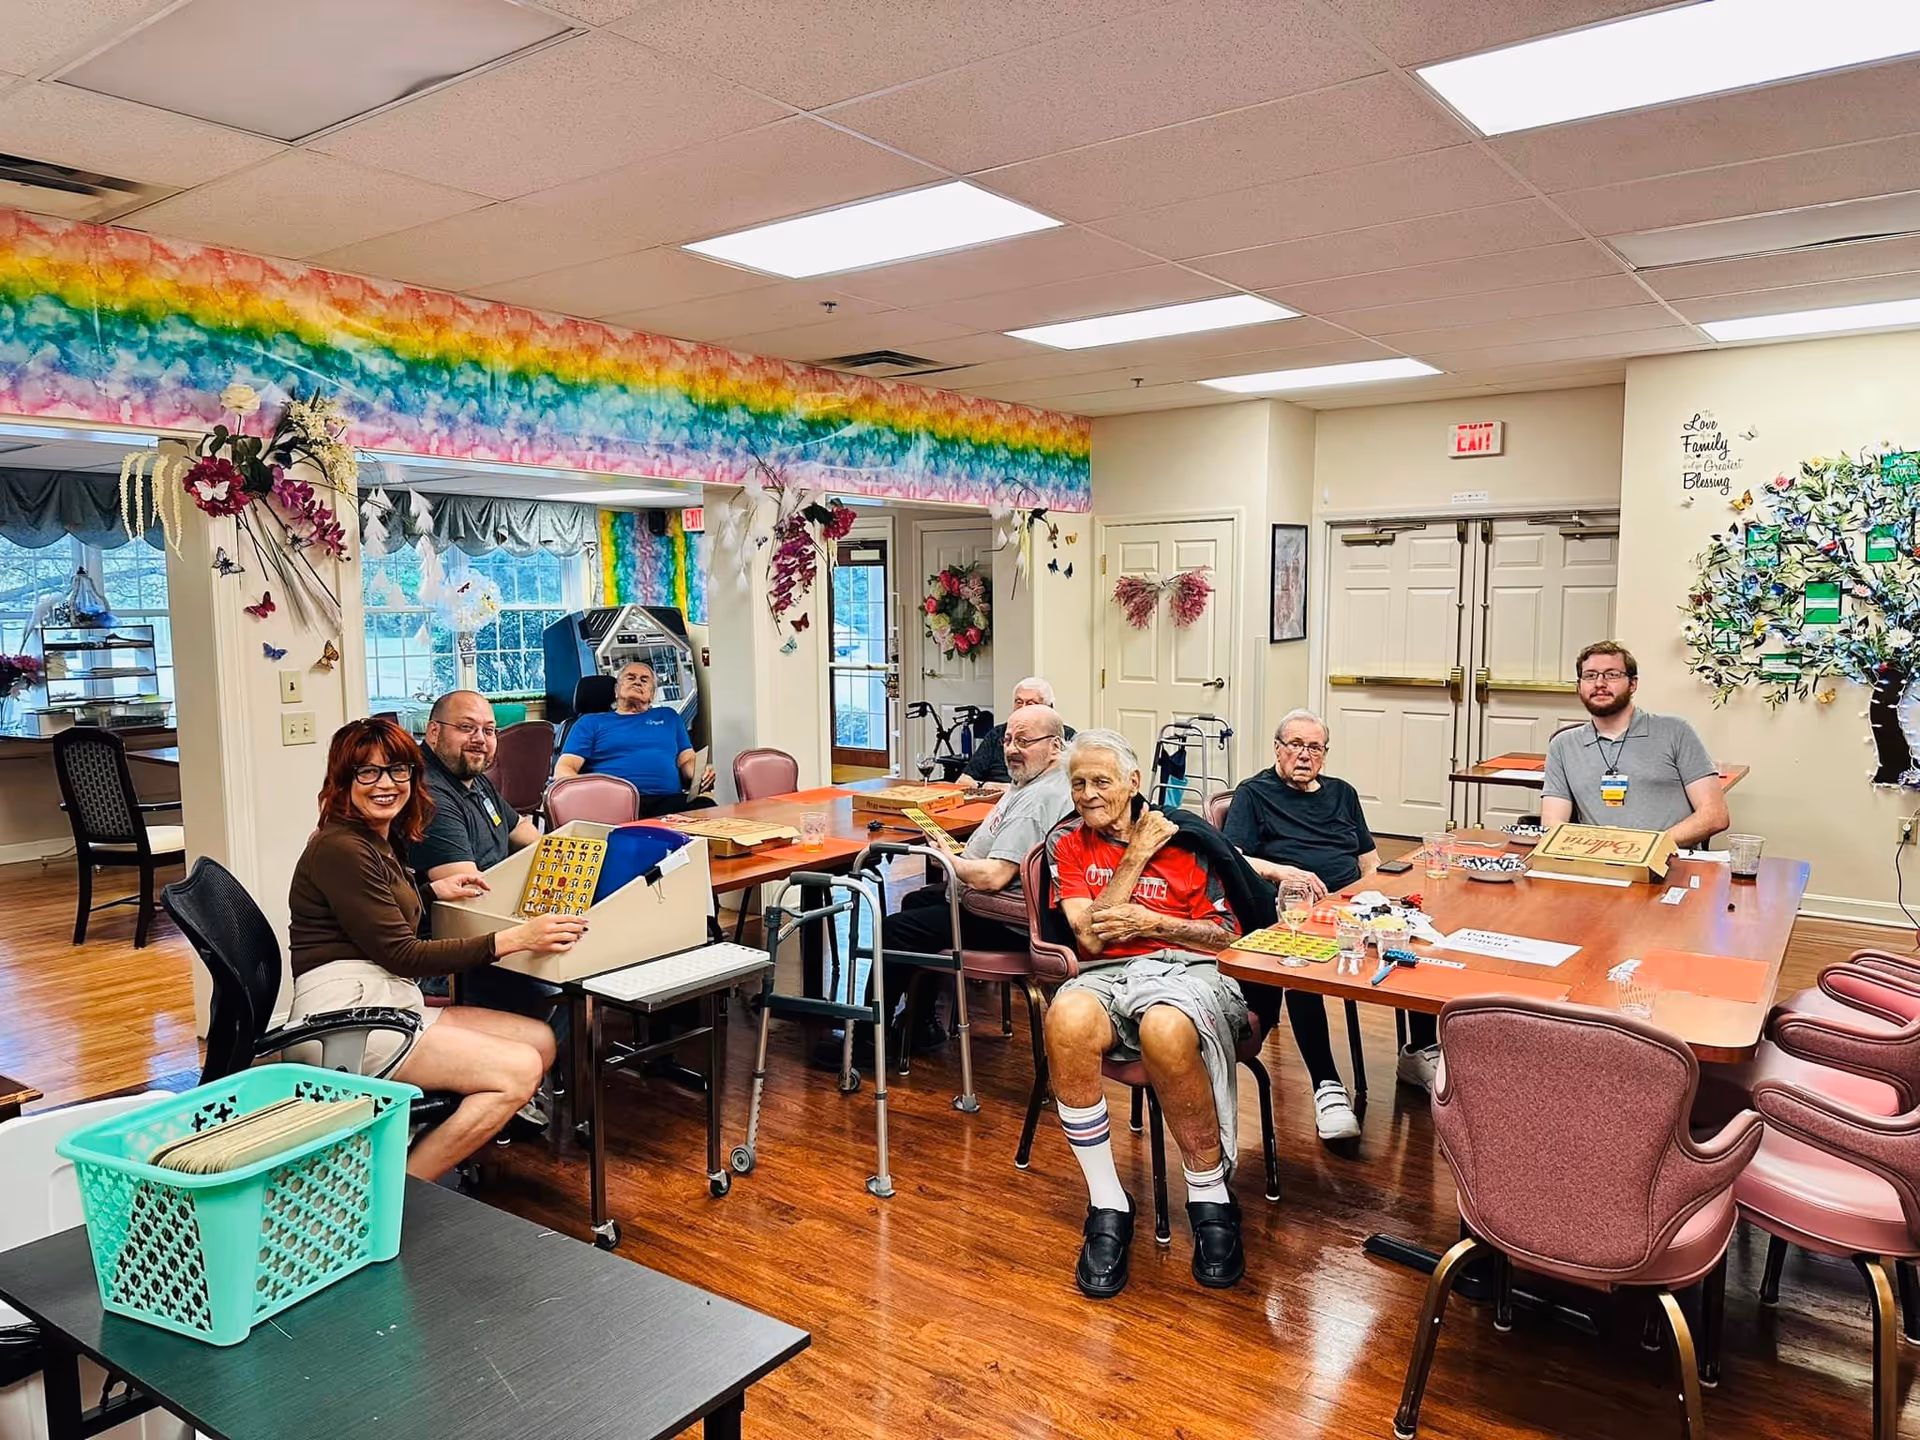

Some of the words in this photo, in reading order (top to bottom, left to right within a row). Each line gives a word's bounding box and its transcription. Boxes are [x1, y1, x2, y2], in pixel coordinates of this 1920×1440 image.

[1683, 413, 1718, 432] Love
[1457, 423, 1494, 452] EXIT
[1680, 432, 1731, 461] Family
[1703, 458, 1744, 473] Greatest
[1682, 472, 1732, 496] Blessing
[685, 509, 702, 529] EXIT
[544, 839, 602, 852] BINGO
